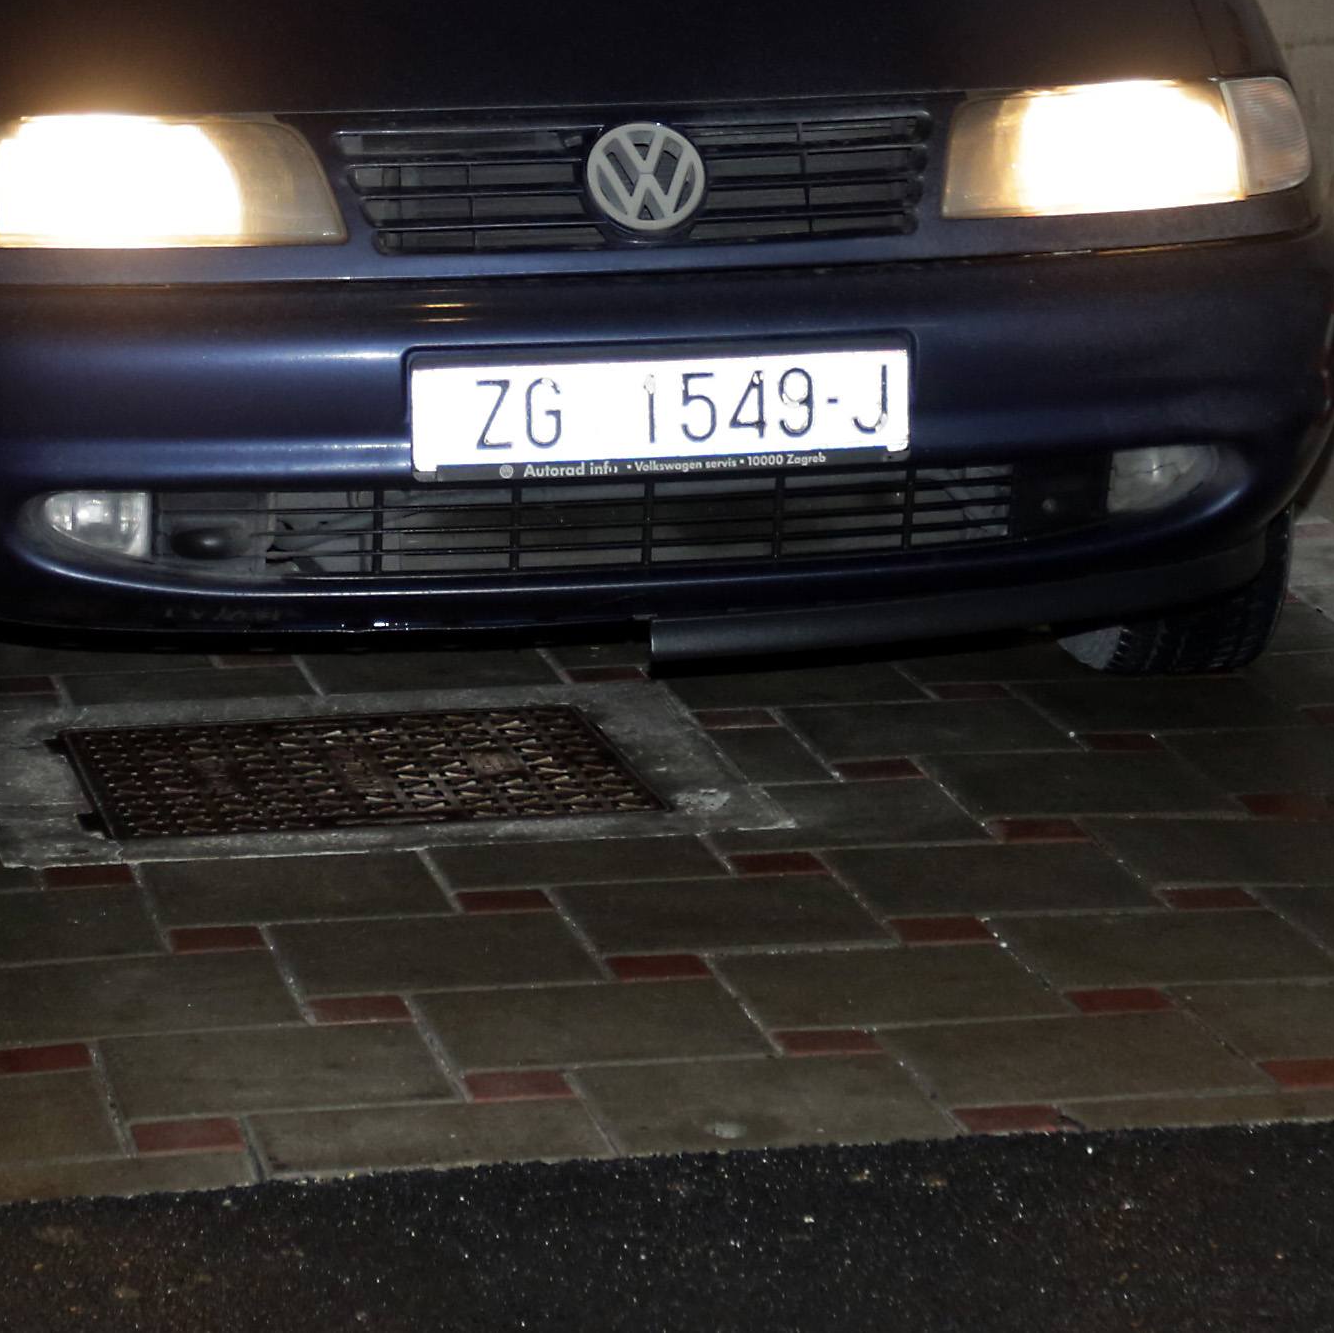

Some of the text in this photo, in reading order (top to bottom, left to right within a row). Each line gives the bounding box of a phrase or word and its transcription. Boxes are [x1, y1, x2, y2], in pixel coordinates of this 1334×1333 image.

[475, 363, 889, 452] ZG 1549-J
[523, 462, 585, 478] Autorad
[634, 460, 703, 473] Volkswagen
[705, 457, 737, 469] servis
[747, 454, 784, 466] 10000
[786, 452, 827, 466] Zagreb
